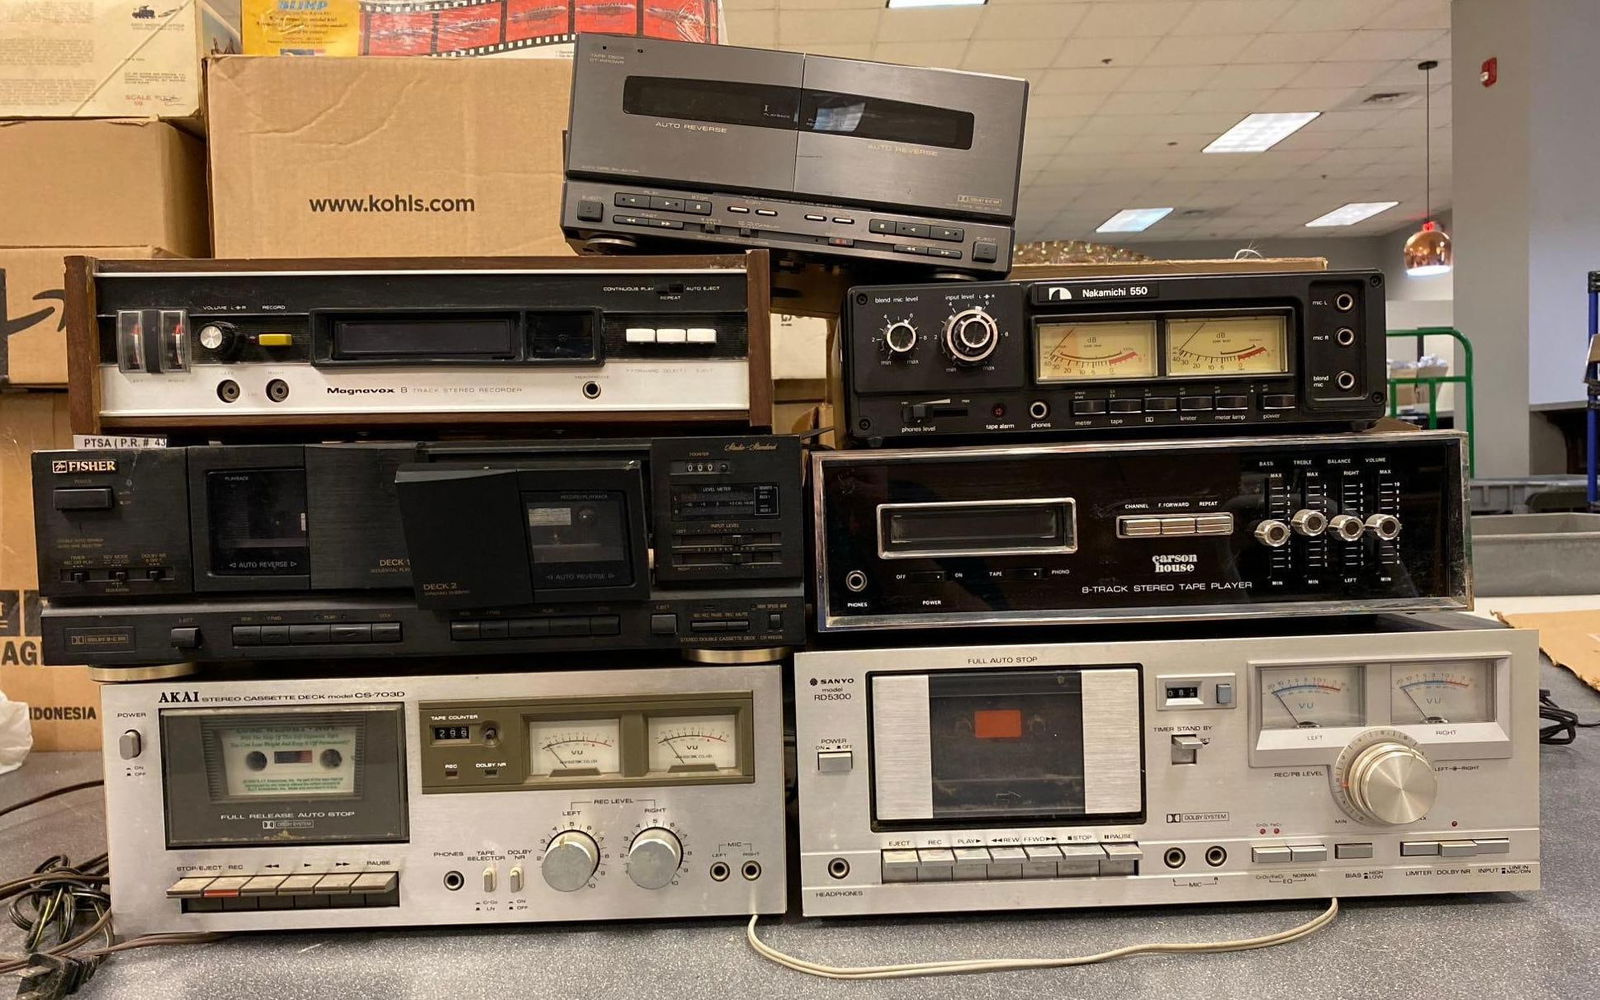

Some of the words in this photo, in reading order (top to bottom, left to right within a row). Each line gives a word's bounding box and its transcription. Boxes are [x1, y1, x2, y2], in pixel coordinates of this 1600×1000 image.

[656, 121, 680, 129] AUTO
[683, 123, 727, 134] REVERSE
[309, 194, 475, 212] www.kohls.com
[1082, 287, 1127, 298] Nakamichi
[1129, 286, 1148, 296] 550
[327, 387, 395, 396] Magnavox
[400, 386, 408, 394] 8
[84, 438, 112, 448] PTSA
[68, 460, 117, 472] FISHER
[379, 559, 405, 567] DECK
[1152, 552, 1198, 564] carson
[1154, 562, 1195, 573] house
[423, 583, 450, 591] DECK
[1081, 584, 1128, 594] 8-TRACK
[1133, 583, 1175, 592] STEREO
[1178, 582, 1206, 591] TAPE
[1210, 580, 1253, 590] PLAYER
[1, 641, 44, 666] AG
[158, 691, 199, 703] AKAI
[814, 693, 852, 701] RD5300
[248, 812, 294, 820] RELEASE
[815, 890, 864, 898] HEADPHONES
